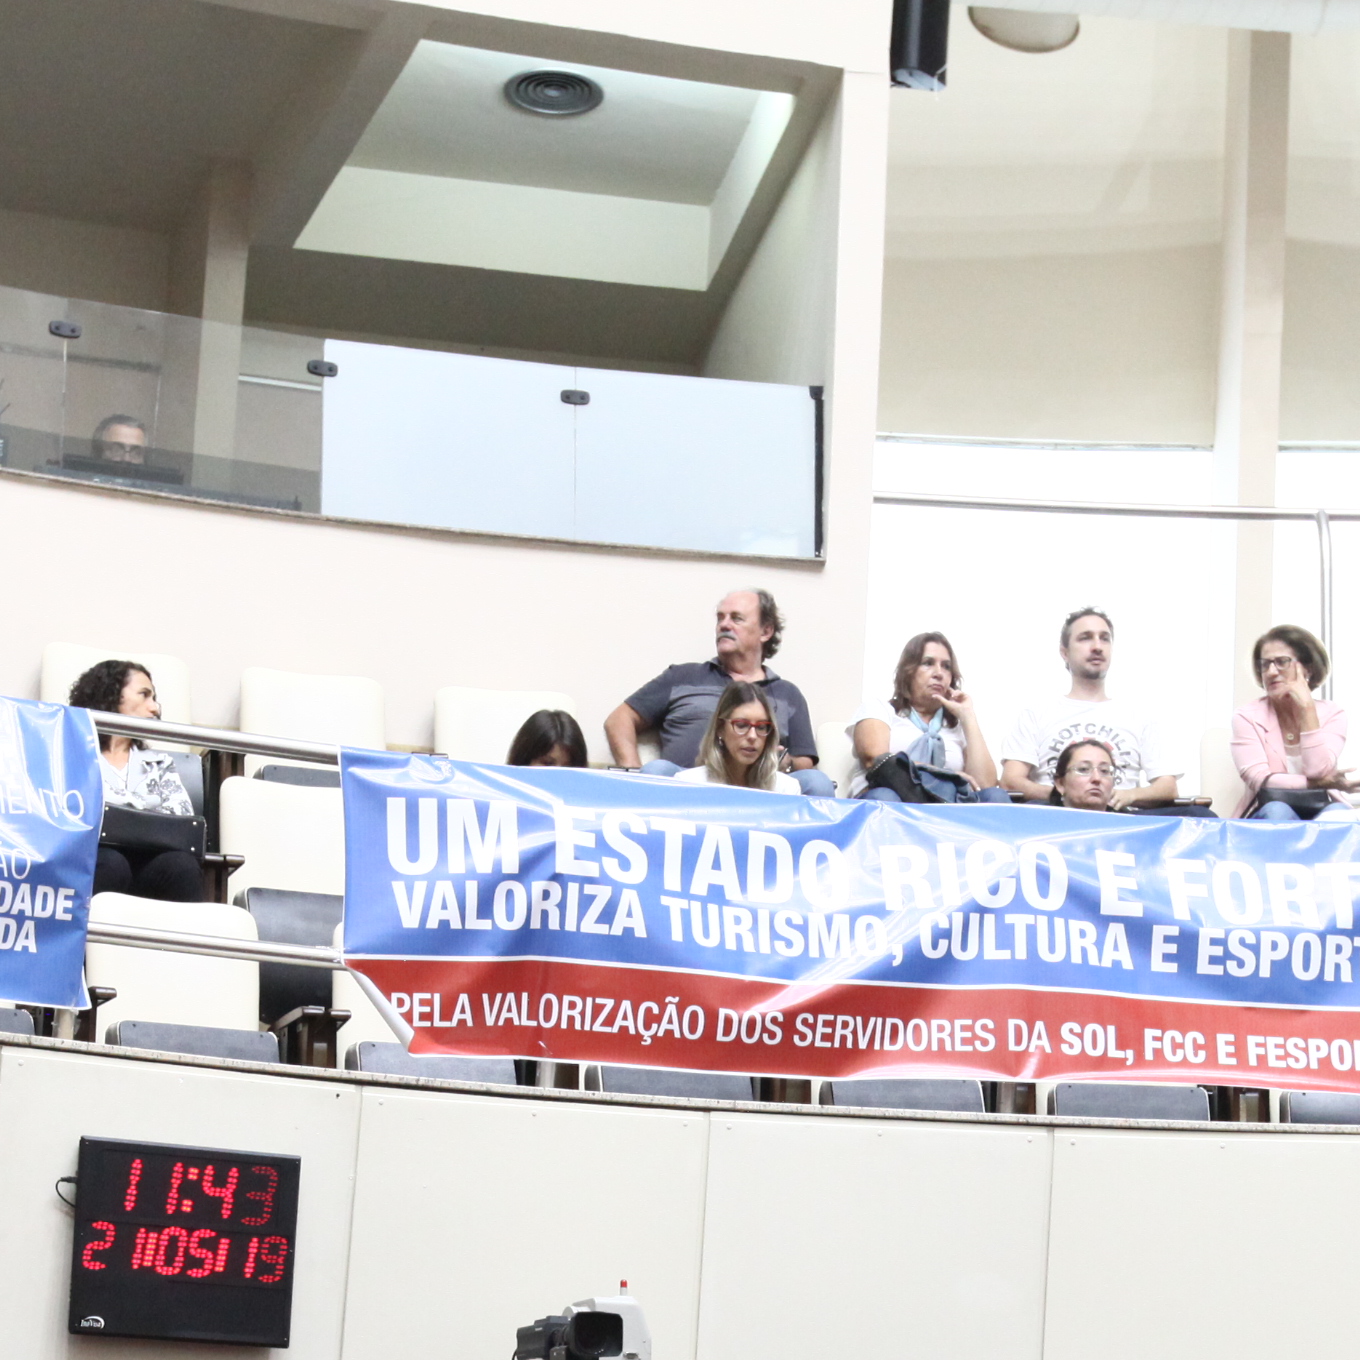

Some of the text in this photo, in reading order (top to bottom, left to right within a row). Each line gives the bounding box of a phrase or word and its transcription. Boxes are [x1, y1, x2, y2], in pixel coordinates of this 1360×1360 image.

[386, 797, 520, 876] UM
[553, 803, 850, 913] ESTADO
[878, 839, 1069, 912] RICO
[1095, 849, 1143, 917] E
[391, 880, 647, 938] VALORIZA
[660, 895, 903, 966] TURISMO,
[919, 911, 1134, 970] CULTURA
[1150, 925, 1180, 973] E
[391, 991, 474, 1027] PELA
[482, 992, 705, 1046] VALORIZAÇÃO
[716, 1007, 784, 1046] DOS
[793, 1012, 996, 1052] SERVIDORES
[1007, 1018, 1052, 1053] DA
[1060, 1021, 1134, 1066] SOL,
[1144, 1028, 1207, 1064] FCC
[1216, 1033, 1238, 1065] E
[124, 1158, 279, 1226] 11:43
